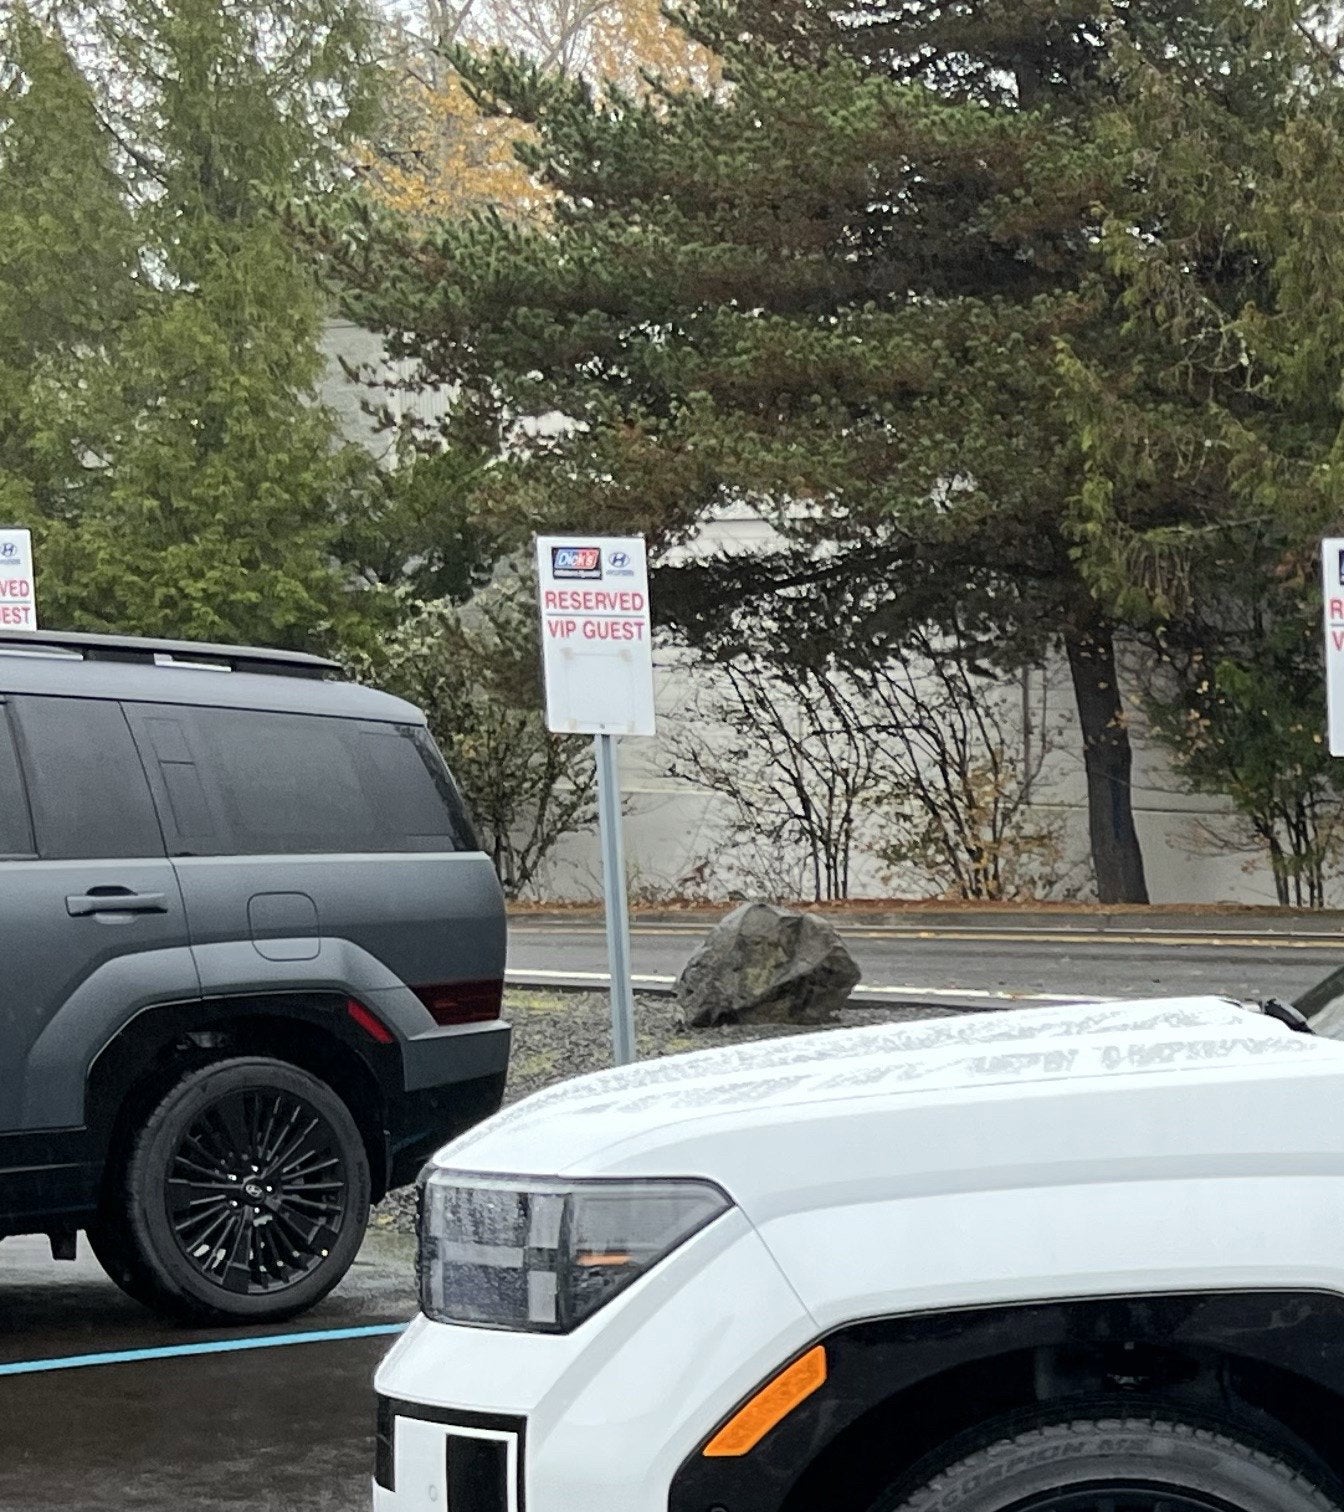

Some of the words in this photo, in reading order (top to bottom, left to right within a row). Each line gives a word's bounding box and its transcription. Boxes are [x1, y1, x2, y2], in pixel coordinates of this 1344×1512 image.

[544, 590, 645, 611] RESERVED
[548, 620, 577, 638] VIP
[583, 620, 646, 641] GUEST
